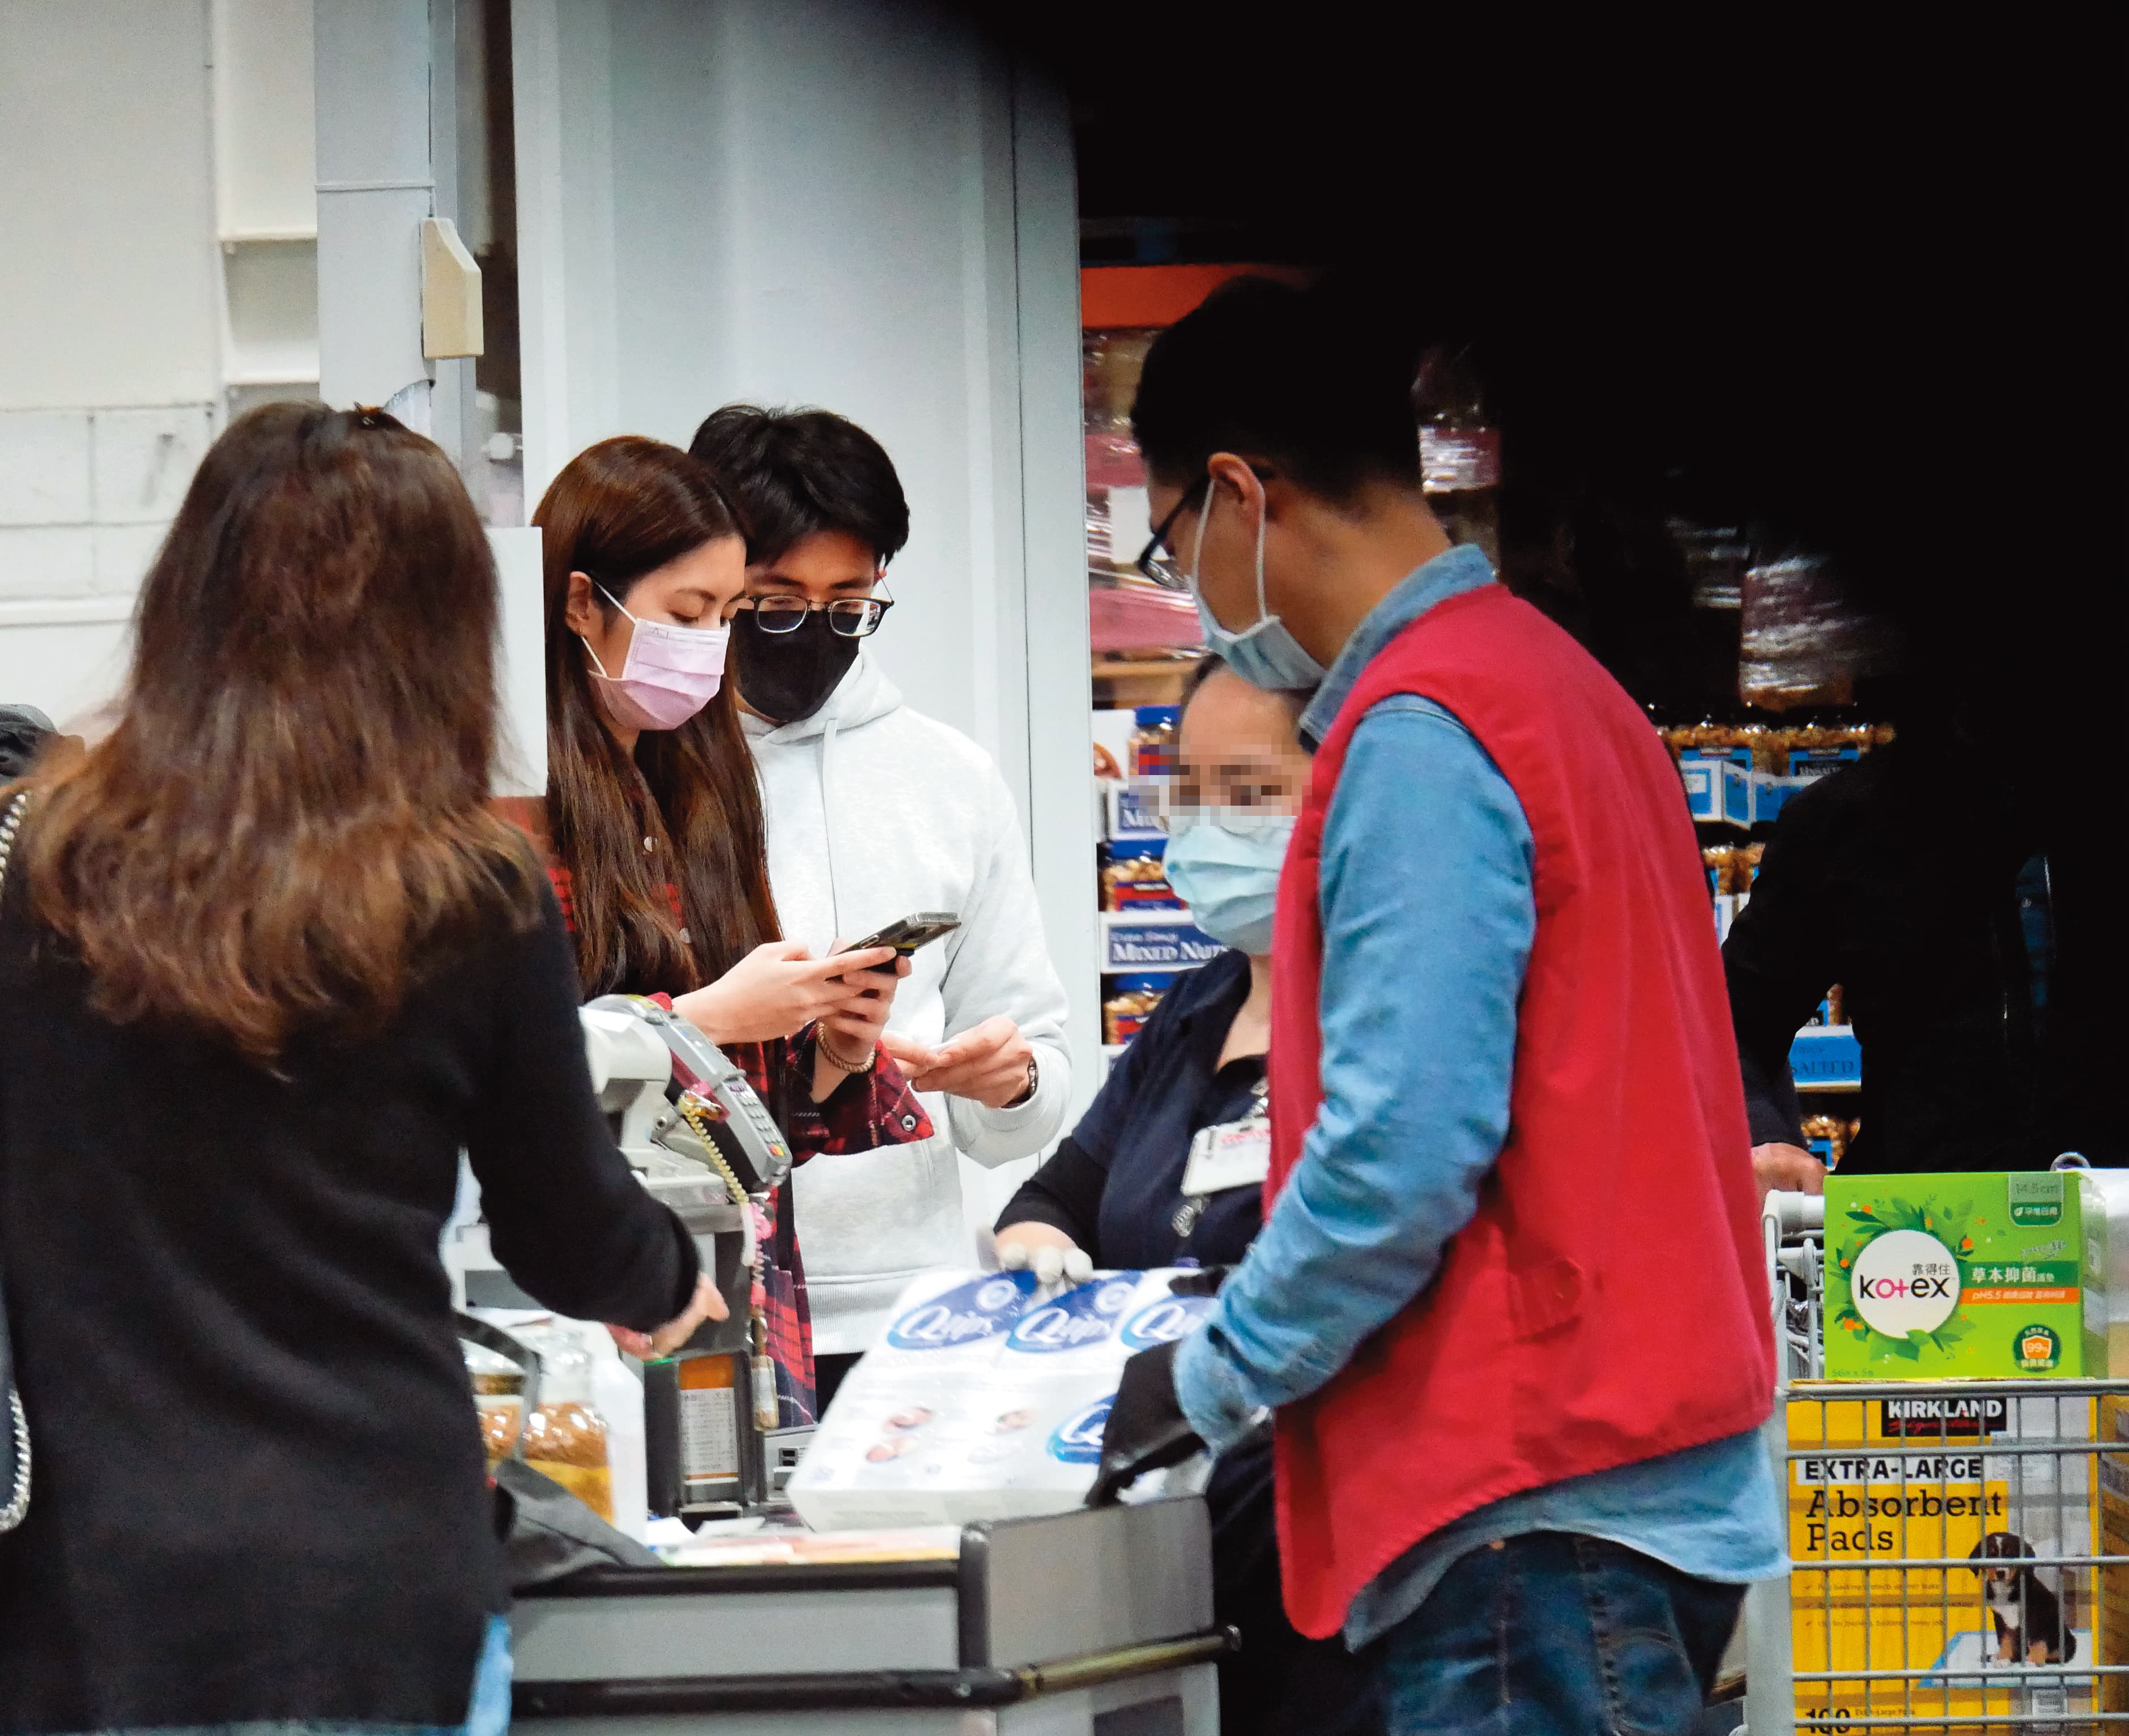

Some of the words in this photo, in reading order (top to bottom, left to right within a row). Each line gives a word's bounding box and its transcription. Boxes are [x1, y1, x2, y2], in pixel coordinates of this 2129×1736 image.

[1912, 1263, 1951, 1275] 靠得住
[1888, 1400, 2002, 1418] KIRKLAND
[1806, 1489, 2002, 1518] Absorbent
[1807, 1522, 1893, 1551] Pads
